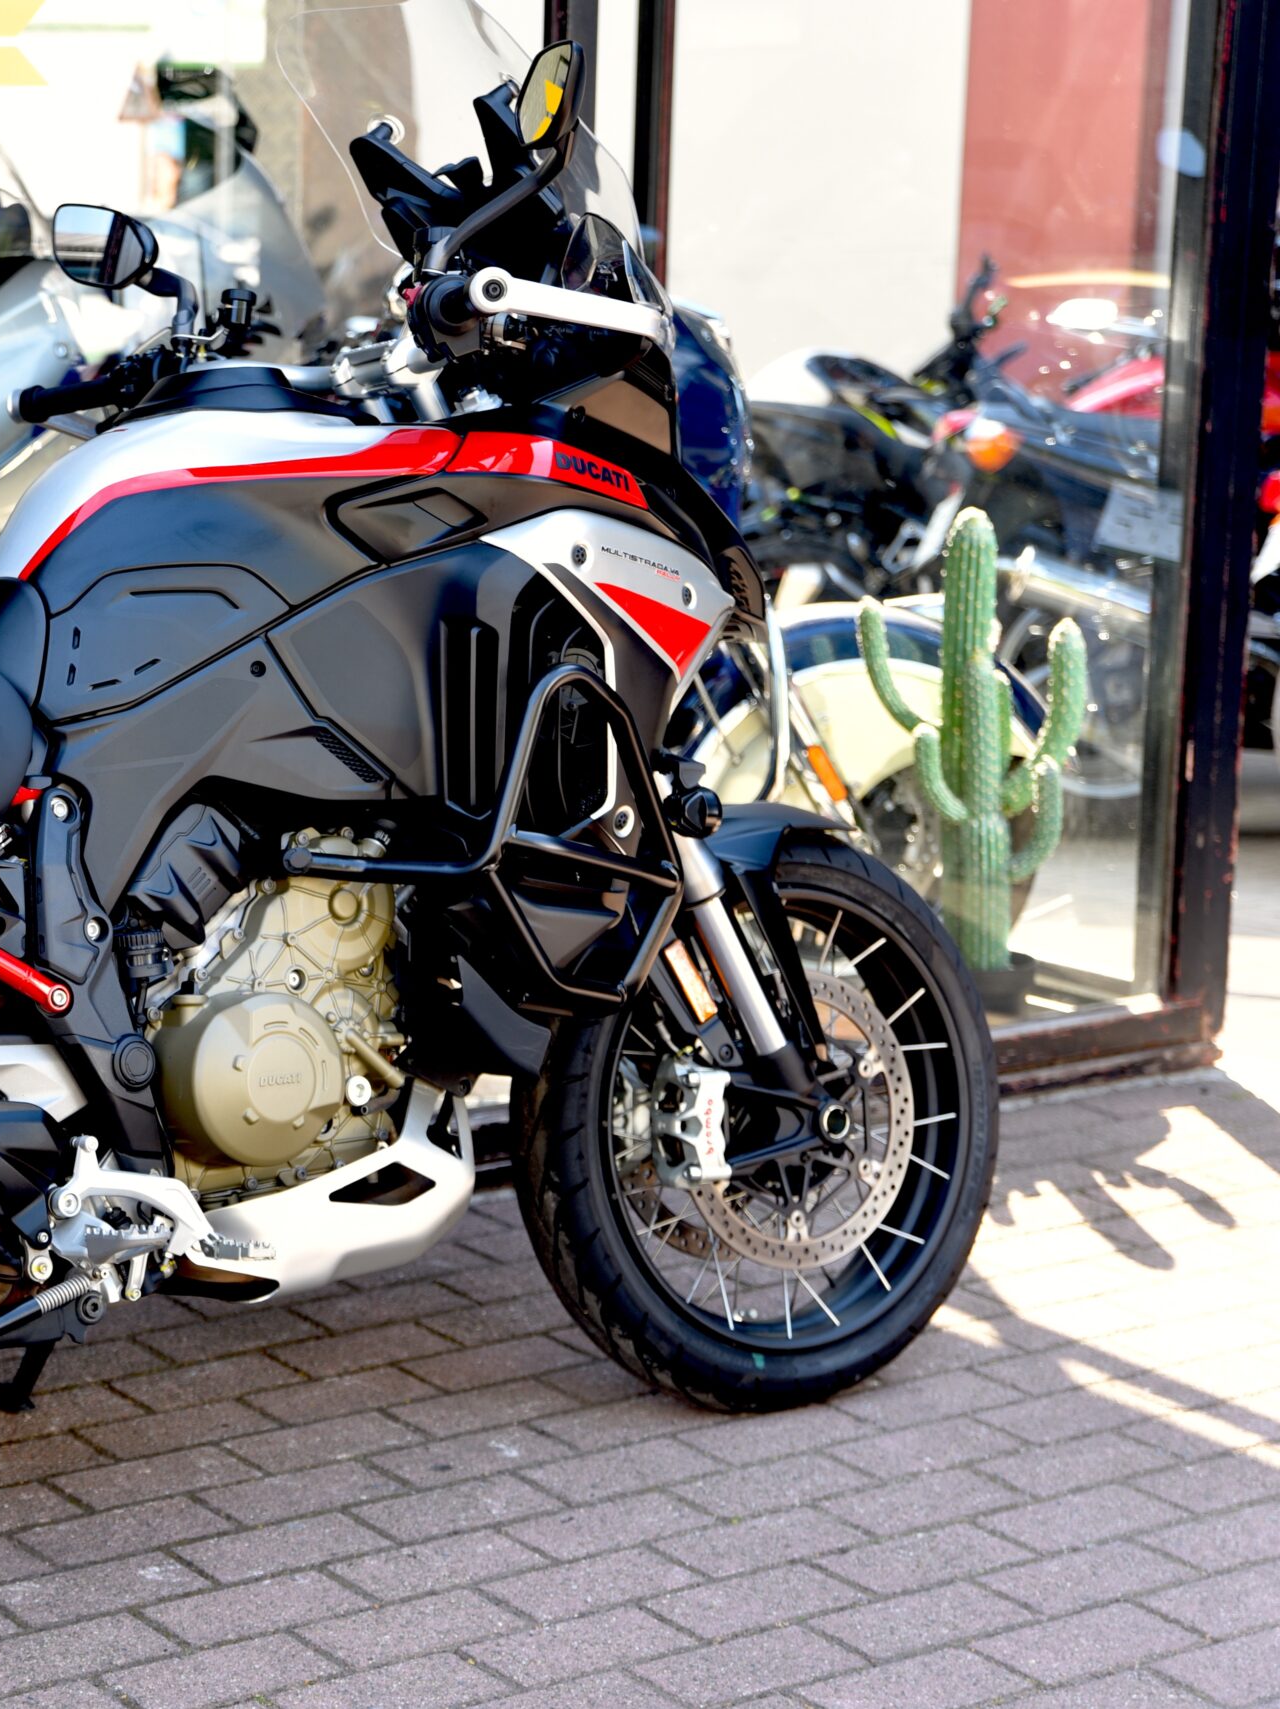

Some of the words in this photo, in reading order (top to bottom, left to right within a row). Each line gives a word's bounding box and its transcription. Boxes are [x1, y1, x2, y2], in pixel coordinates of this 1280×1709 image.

[555, 452, 630, 492] DUCATI
[601, 546, 668, 572] MULTISTRADA
[259, 1073, 302, 1088] DUCATI
[704, 1098, 715, 1156] brembo
